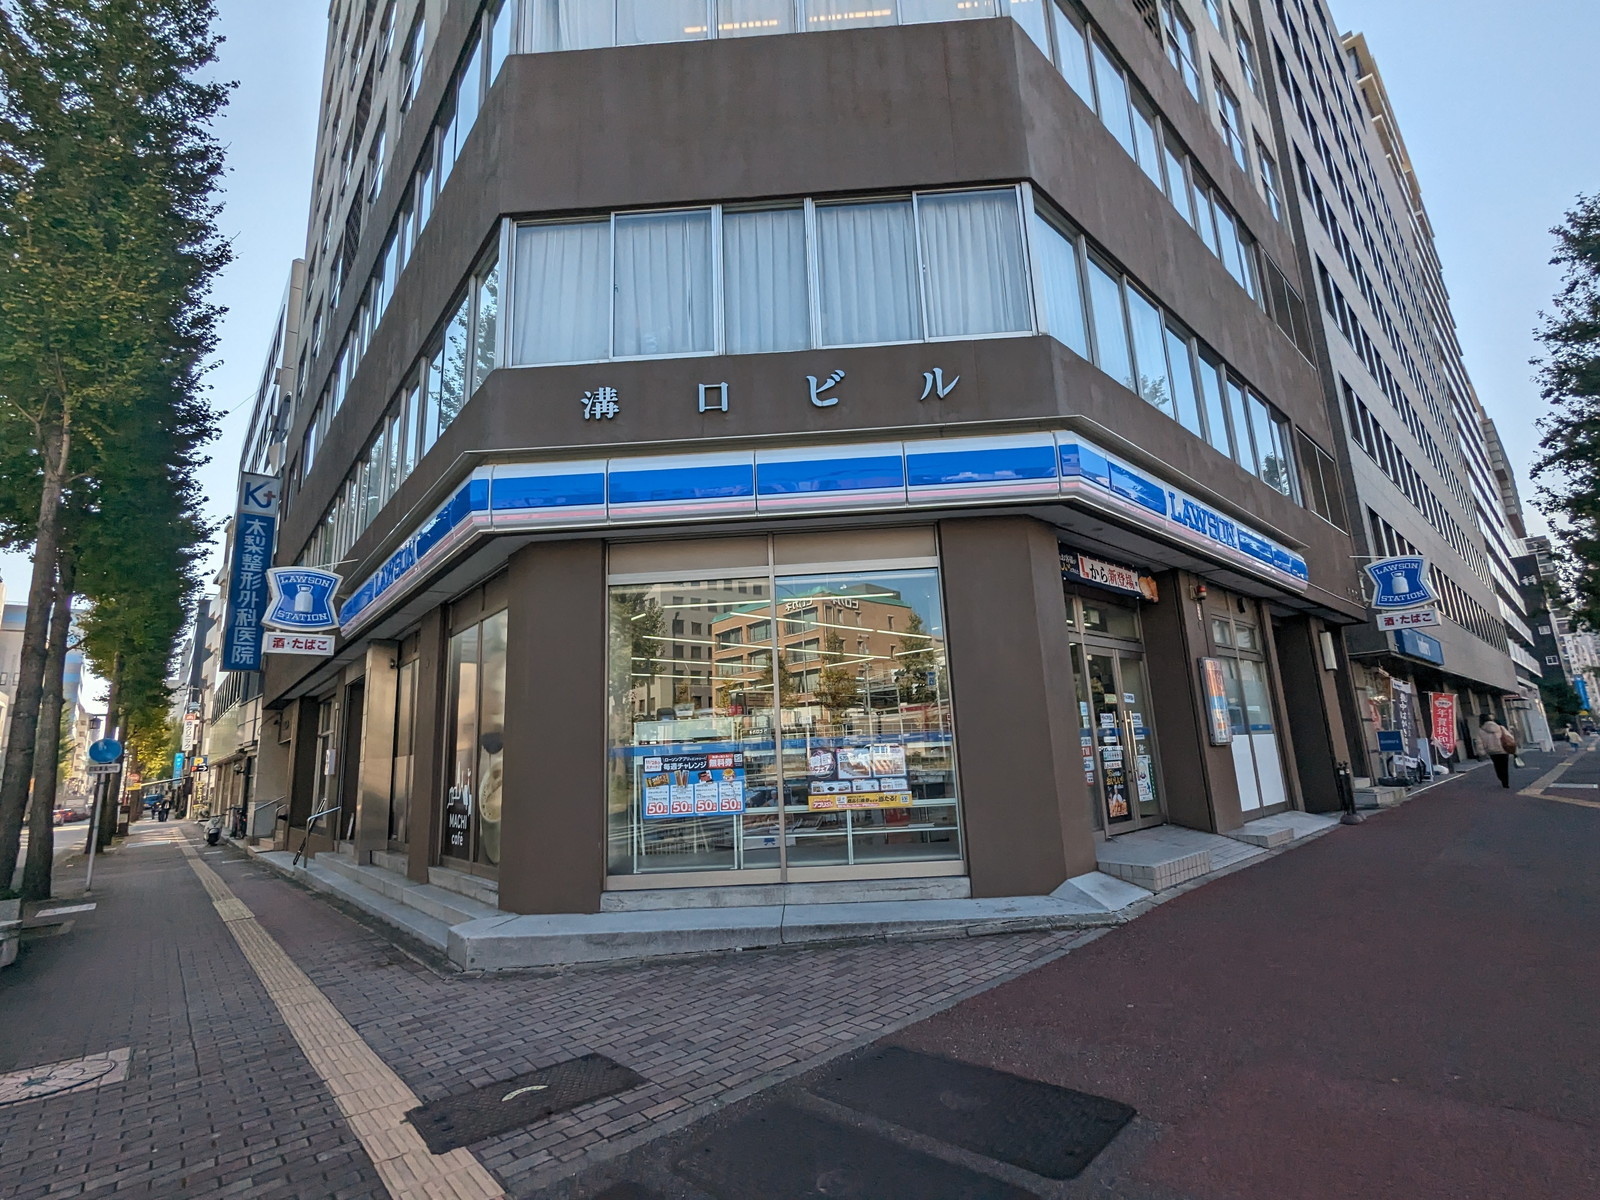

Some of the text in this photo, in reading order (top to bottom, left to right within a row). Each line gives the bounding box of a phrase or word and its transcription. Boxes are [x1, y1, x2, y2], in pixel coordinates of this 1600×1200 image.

[579, 366, 961, 420] 溝口ビル
[1168, 490, 1239, 548] LAWSON
[373, 536, 418, 599] LAWSON
[1375, 562, 1419, 575] LAWSON
[279, 575, 330, 589] LAWSON
[231, 518, 268, 665] 木梨整形外科医院
[1381, 590, 1424, 602] STATION
[277, 610, 328, 622] STATION
[1383, 612, 1433, 625] 酒・たばこ
[272, 637, 328, 651] 酒・たばこ
[449, 813, 468, 830] MACHI
[451, 830, 464, 846] café
